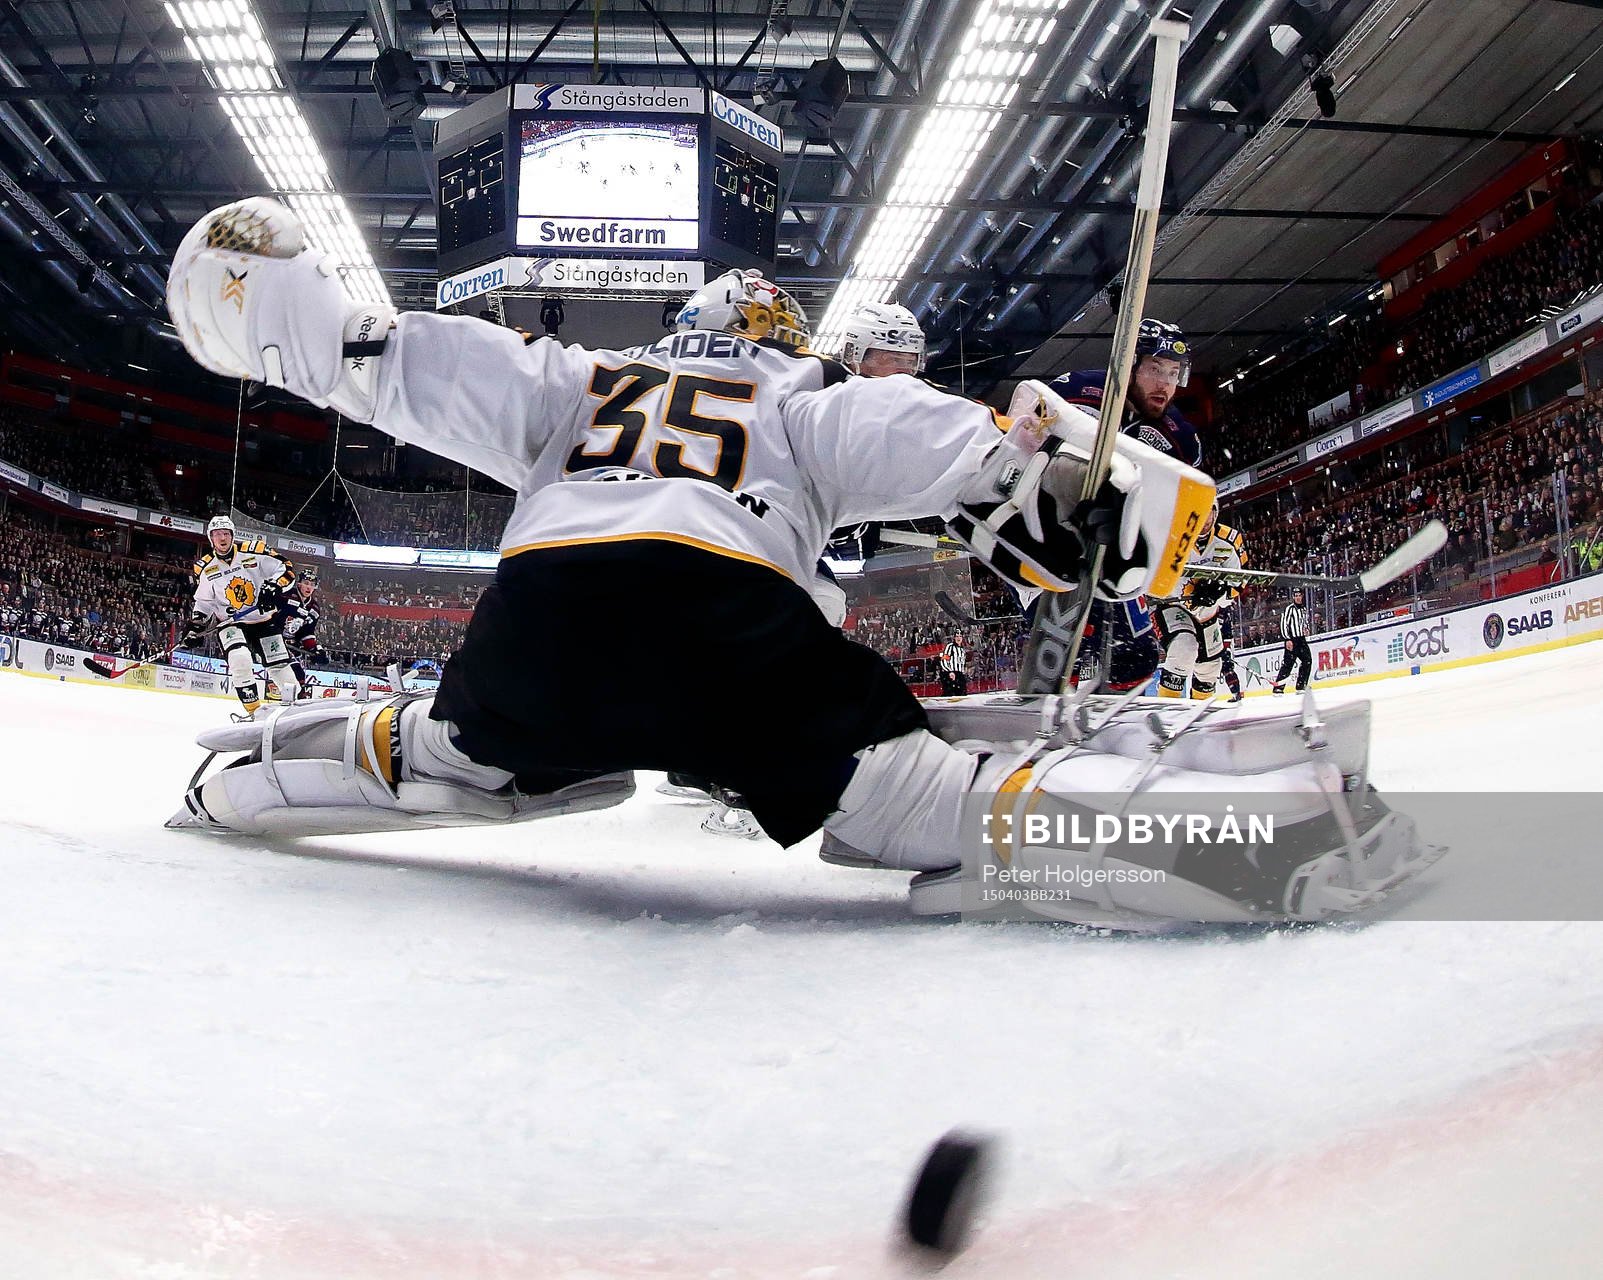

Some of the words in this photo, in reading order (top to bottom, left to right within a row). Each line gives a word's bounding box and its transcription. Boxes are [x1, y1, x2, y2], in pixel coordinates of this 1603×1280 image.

[561, 87, 690, 109] Stångåstaden
[713, 97, 780, 149] Corren
[540, 221, 666, 245] Swedfarm
[440, 266, 504, 305] Corren
[553, 262, 688, 287] Stångåstaden
[355, 316, 376, 371] Reeok
[564, 361, 758, 492] 35
[1171, 510, 1201, 574] CCM
[1530, 589, 1566, 605] KONFERERA
[1507, 610, 1554, 636] SAAB
[1404, 617, 1450, 659] east
[55, 653, 75, 667] SAAB
[1318, 645, 1354, 671] RIX
